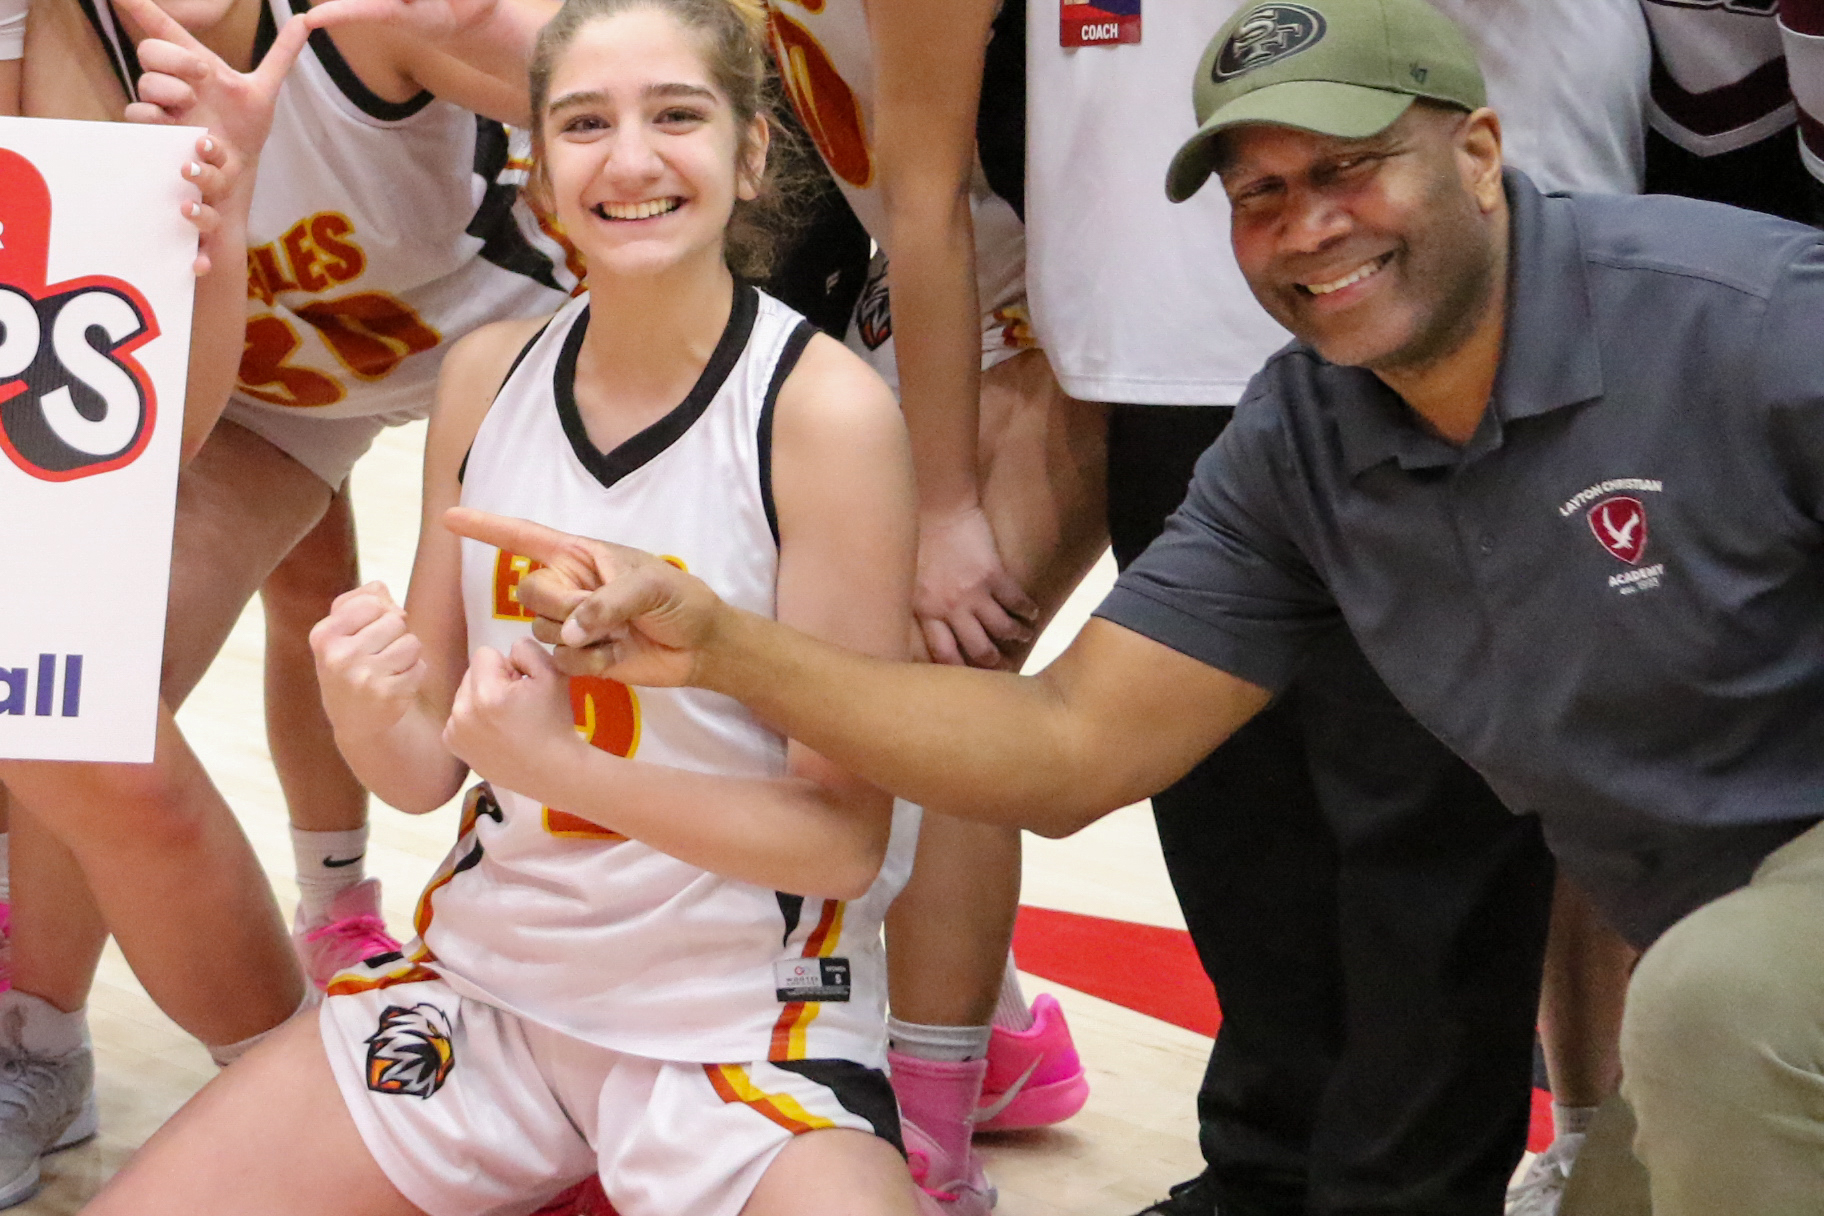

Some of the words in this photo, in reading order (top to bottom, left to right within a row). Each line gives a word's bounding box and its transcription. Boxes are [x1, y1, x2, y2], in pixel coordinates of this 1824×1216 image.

[1081, 23, 1119, 41] COACH
[1559, 483, 1604, 516] LAYTON
[1608, 563, 1664, 588] ACADEMY
